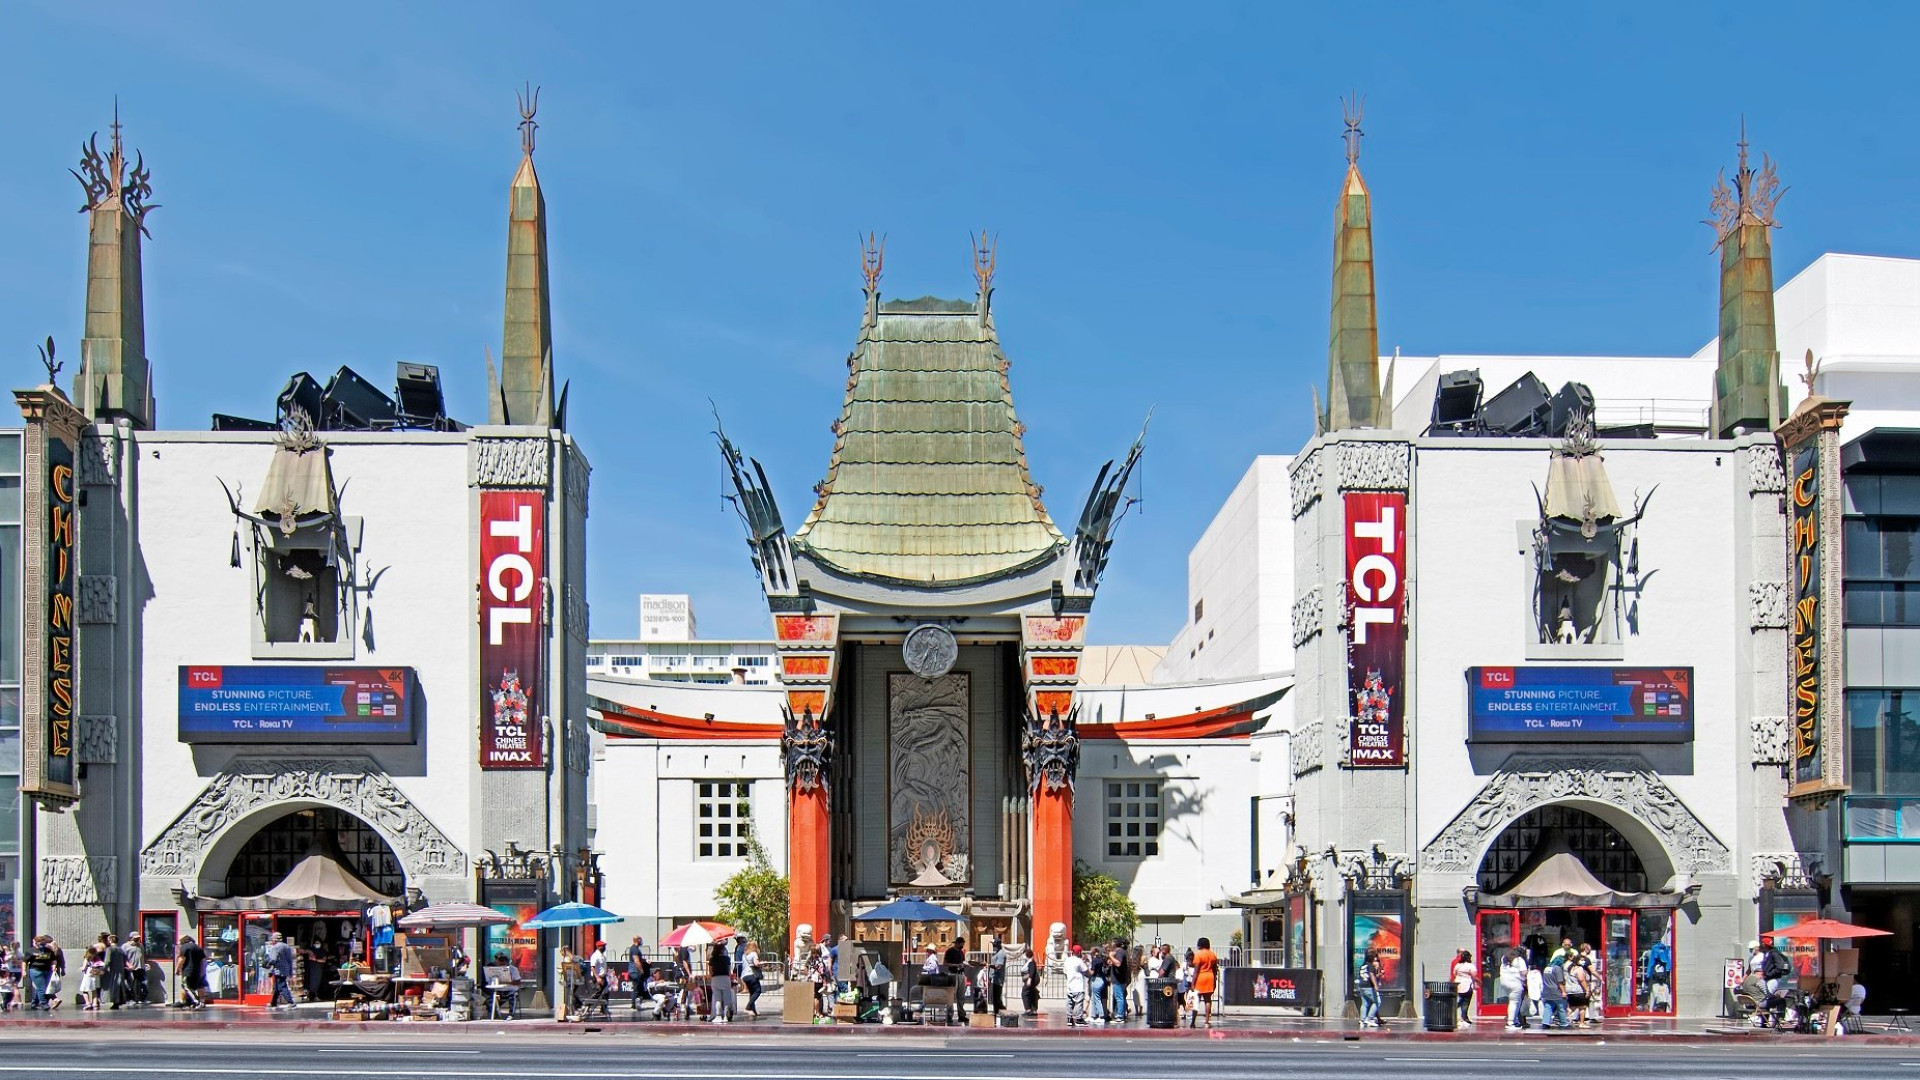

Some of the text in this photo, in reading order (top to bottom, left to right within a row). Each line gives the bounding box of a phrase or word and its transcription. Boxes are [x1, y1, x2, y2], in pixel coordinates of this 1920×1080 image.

[489, 505, 534, 645] TCL
[1353, 507, 1396, 644] TCL
[643, 599, 686, 609] madison
[52, 464, 72, 757] CHINESE
[1794, 467, 1816, 758] CHINESE
[193, 672, 218, 682] TCL
[389, 671, 402, 681] 4K
[1486, 672, 1510, 682] TCL
[1674, 672, 1687, 681] 4K
[211, 690, 314, 699] STUNNING PICTURE.
[1504, 690, 1602, 699] STUNNING PICTURE.
[194, 702, 331, 712] ENDLESS ENTERTAINMENT.
[1488, 702, 1620, 711] ENDLESS ENTERTAINMENT.
[233, 720, 253, 728] TCL
[281, 720, 293, 728] TV
[1525, 719, 1544, 728] TCL
[1571, 719, 1583, 728] TV
[495, 726, 527, 736] TCL
[1358, 724, 1388, 735] TCL
[490, 751, 533, 761] IMAX
[1352, 749, 1394, 759] IMAX
[1270, 978, 1296, 988] TCL
